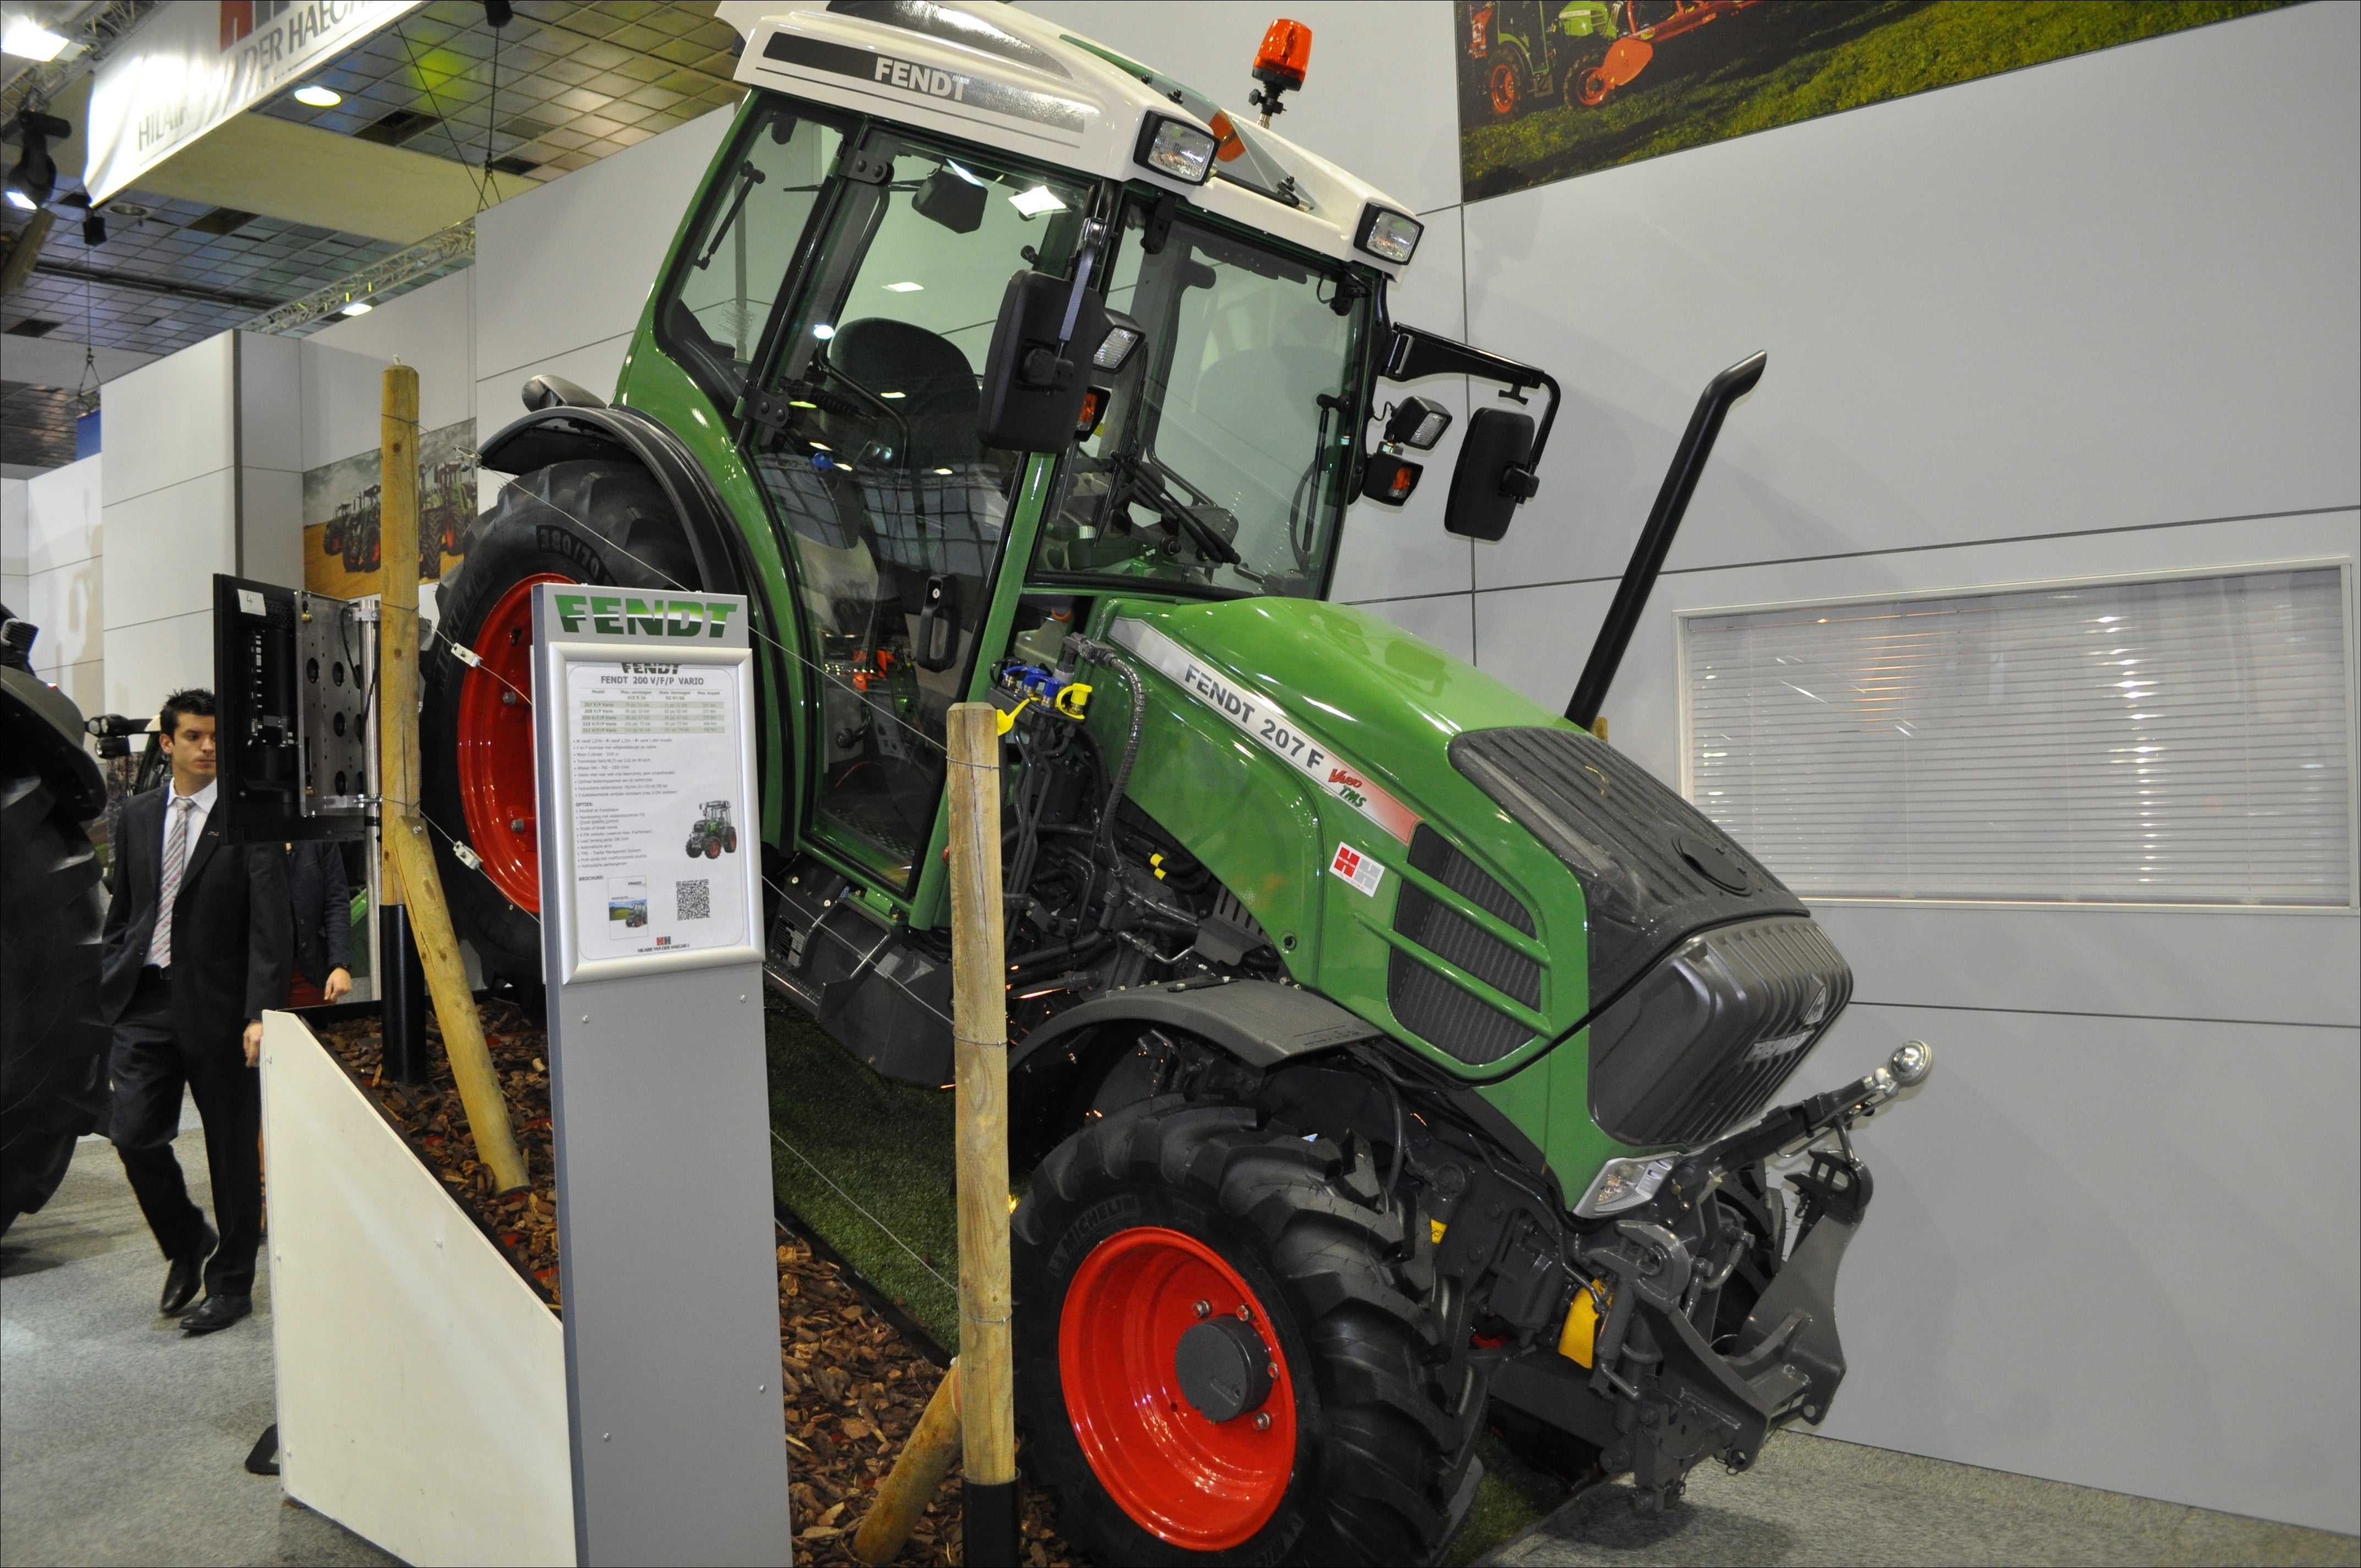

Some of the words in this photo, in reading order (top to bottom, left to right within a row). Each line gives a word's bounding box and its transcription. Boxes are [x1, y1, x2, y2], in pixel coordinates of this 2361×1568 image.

[875, 57, 970, 101] FENDT
[246, 594, 253, 606] 4
[555, 594, 738, 638] FENDT
[621, 662, 682, 675] FENDT
[600, 676, 628, 684] FENDT
[650, 677, 675, 686] V/F/P
[679, 677, 704, 686] VARIO
[1184, 664, 1255, 723] FENDT
[1260, 719, 1305, 757] 207
[1306, 748, 1324, 769] F
[1339, 785, 1367, 808] TMS
